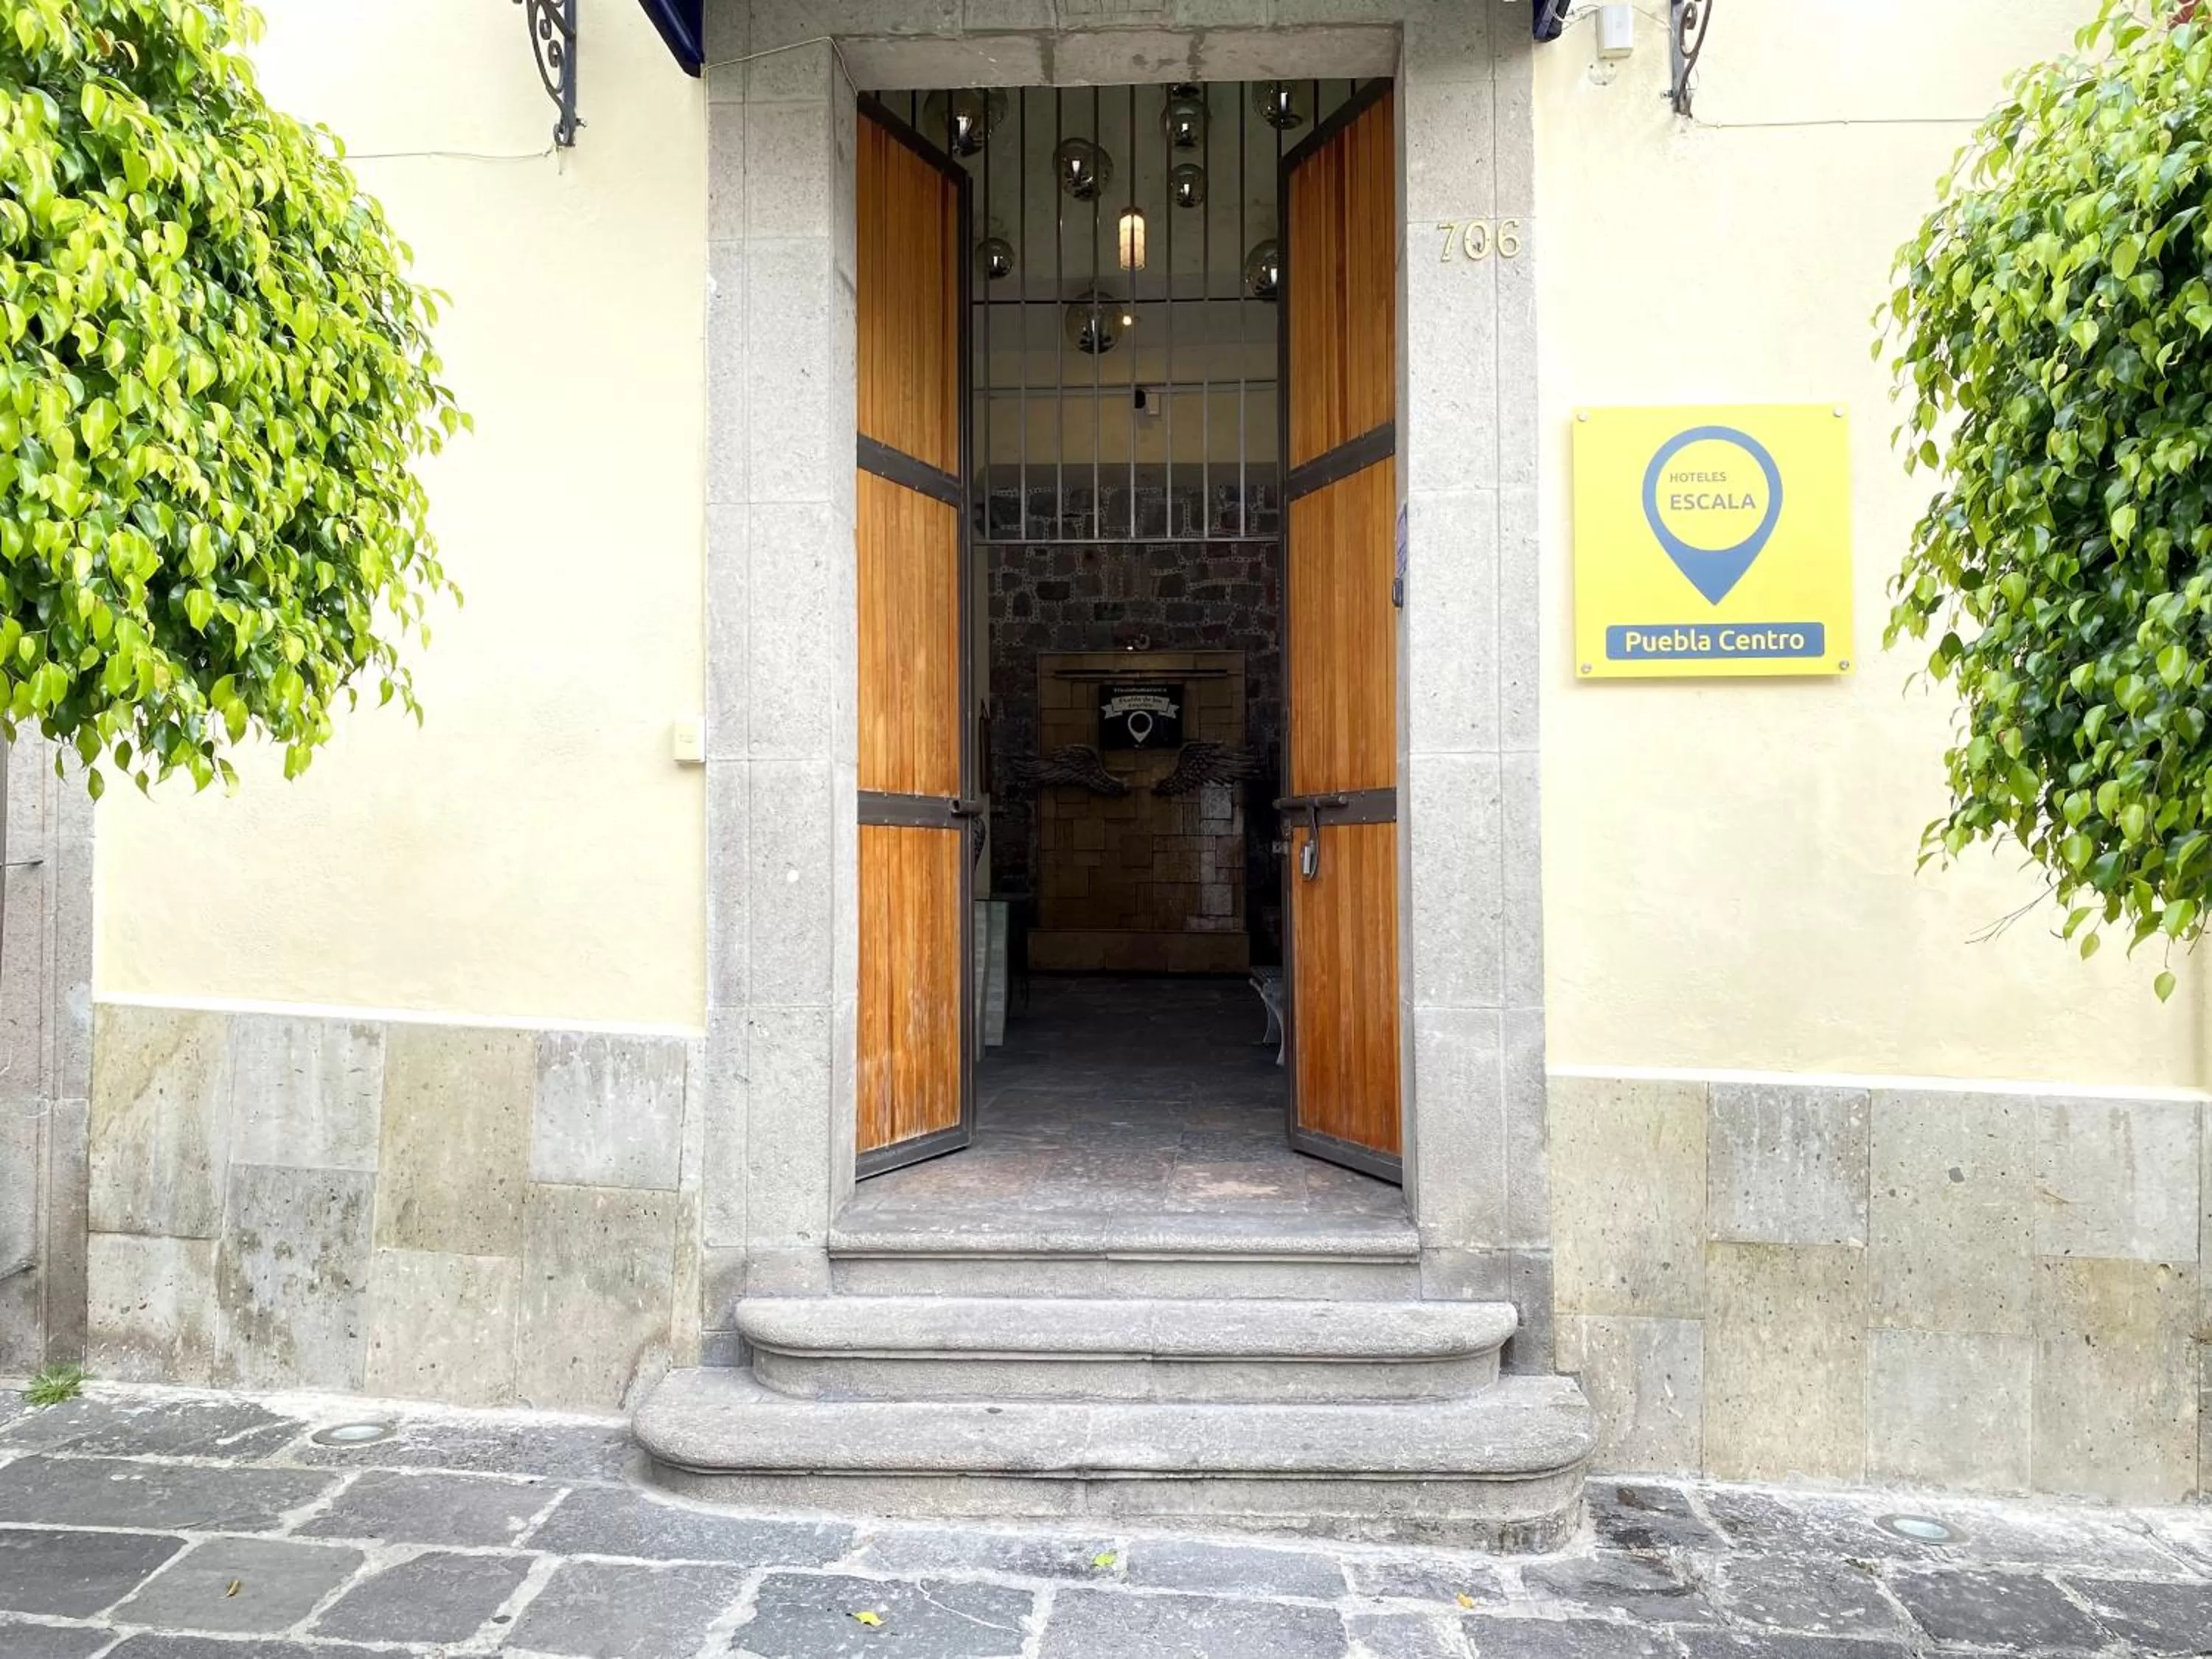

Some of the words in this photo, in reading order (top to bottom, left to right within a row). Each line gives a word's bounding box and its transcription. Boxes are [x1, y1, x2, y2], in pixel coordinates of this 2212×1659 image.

[1437, 218, 1521, 262] 706
[1669, 472, 1726, 483] HOTELES
[1670, 493, 1756, 510] ESCALA
[1625, 629, 1711, 653] Puebla
[1719, 630, 1805, 651] Centro
